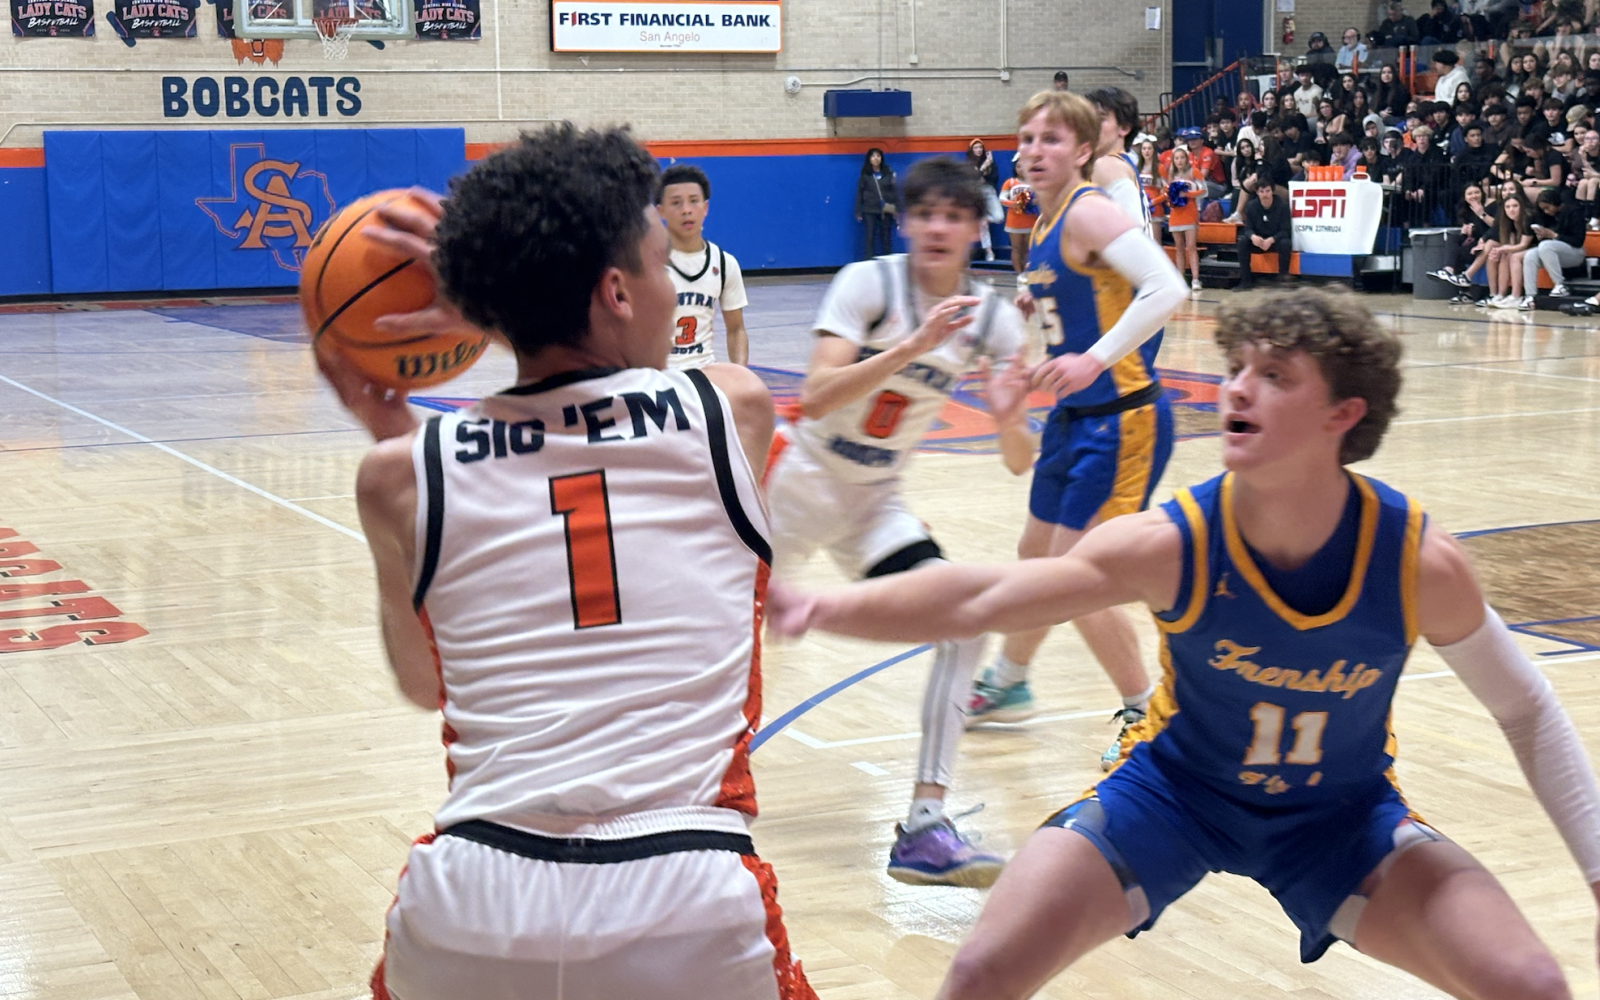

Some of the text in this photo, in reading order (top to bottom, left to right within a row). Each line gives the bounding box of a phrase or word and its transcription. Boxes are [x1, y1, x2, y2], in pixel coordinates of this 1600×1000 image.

[18, 3, 87, 20] LADY CATS
[122, 4, 189, 21] LADY CATS
[414, 8, 475, 24] LADY CATS
[559, 11, 771, 27] FIRST FINANCIAL BANK
[639, 31, 701, 44] San Angelo
[162, 76, 362, 117] BOBCATS
[675, 316, 698, 345] 3
[864, 390, 908, 438] 0
[549, 467, 622, 630] 1
[1207, 639, 1382, 699] Frenship
[1242, 702, 1329, 766] 11
